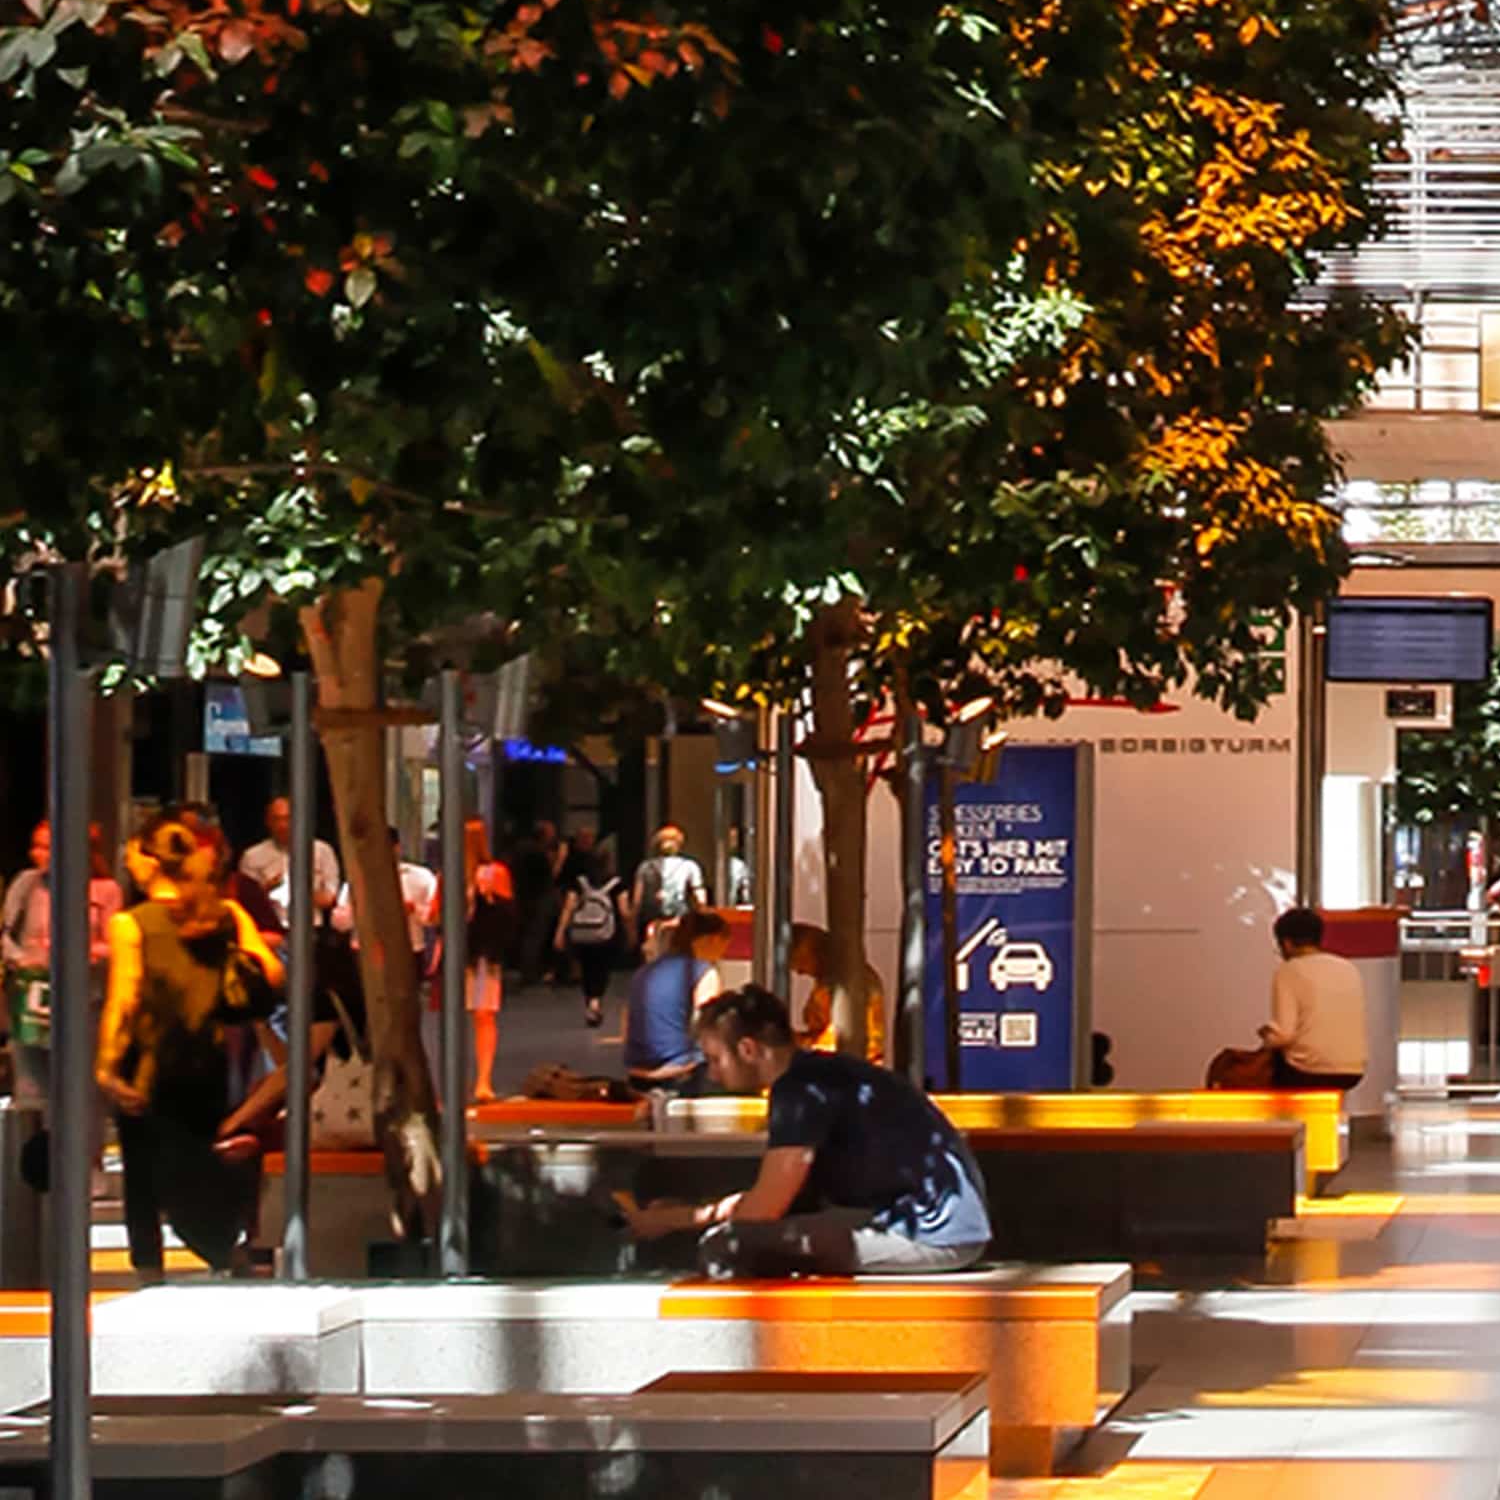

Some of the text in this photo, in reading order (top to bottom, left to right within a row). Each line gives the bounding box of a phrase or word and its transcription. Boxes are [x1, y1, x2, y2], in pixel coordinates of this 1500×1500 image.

[987, 839, 1030, 858] HIER
[1034, 839, 1068, 857] MIT
[928, 858, 974, 875] ESY
[981, 858, 1009, 875] TO
